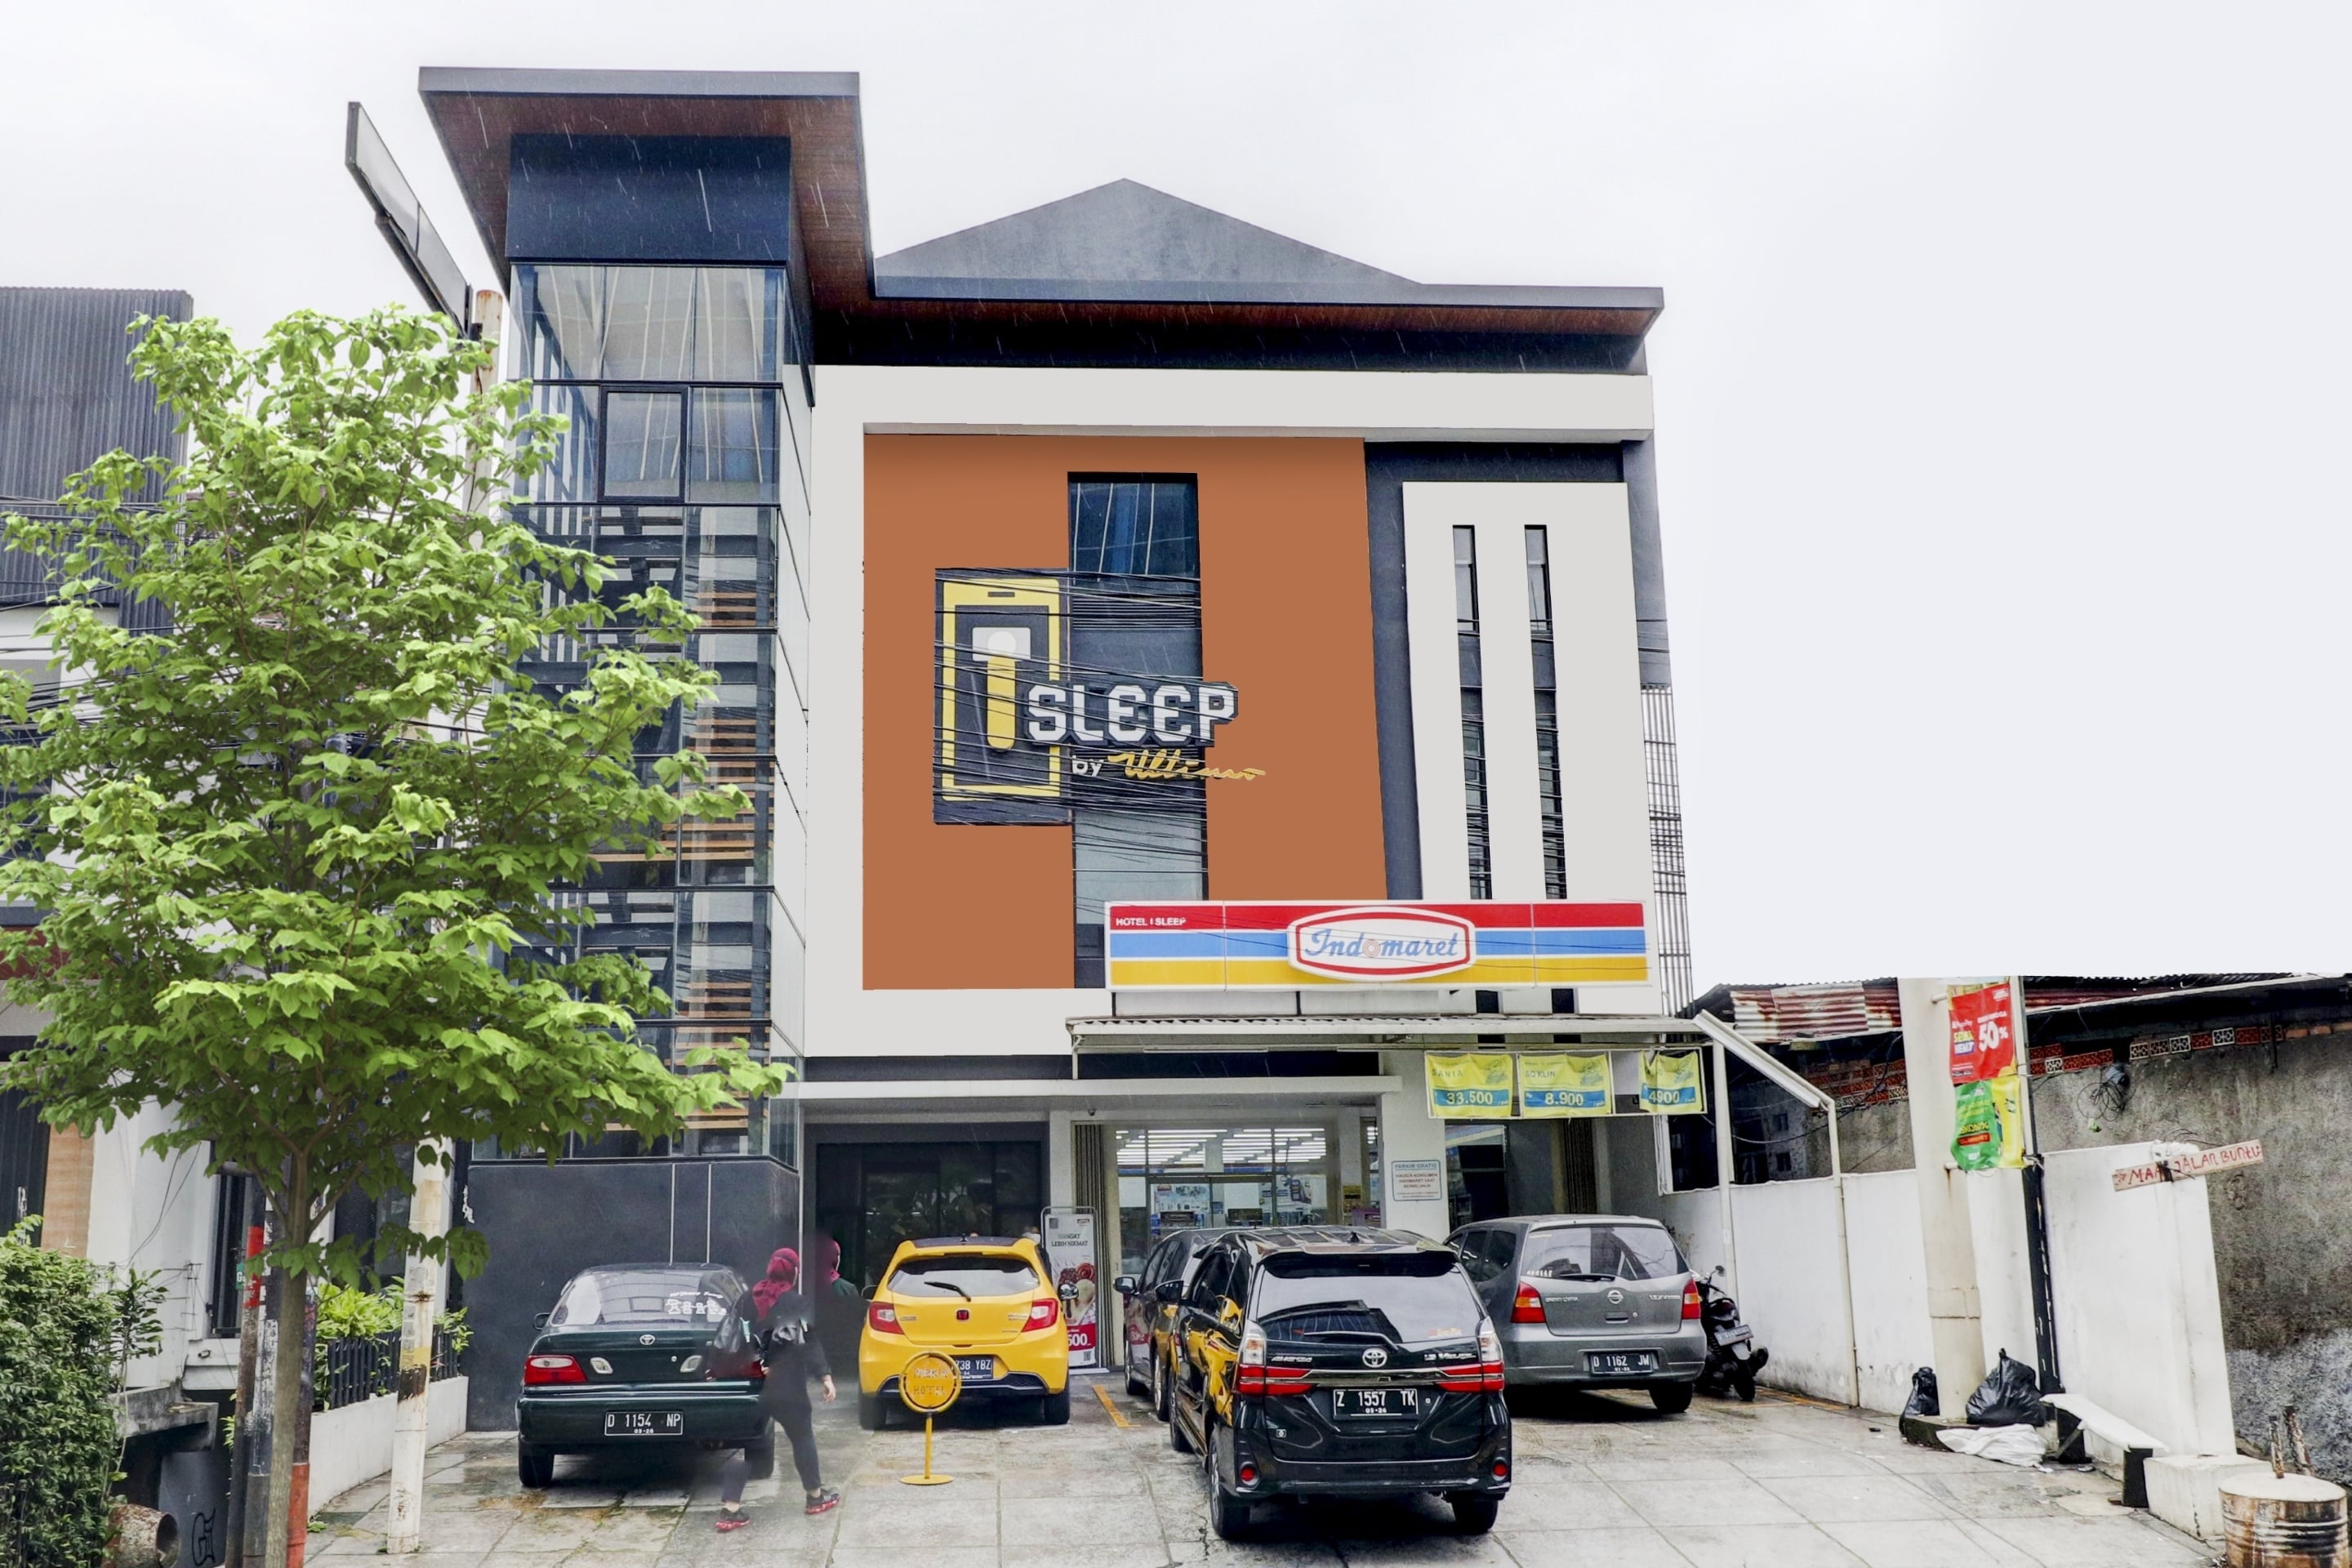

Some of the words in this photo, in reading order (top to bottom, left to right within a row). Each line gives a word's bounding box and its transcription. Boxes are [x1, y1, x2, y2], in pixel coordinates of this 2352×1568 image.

[1027, 684, 1236, 742] SLEEP
[1071, 755, 1104, 777] by
[1116, 917, 1148, 926] HOTEL
[1155, 916, 1187, 926] SLEEP
[1305, 928, 1459, 957] Indomaret
[1446, 1091, 1494, 1105] 33.500
[1544, 1092, 1584, 1106] 8.900
[2174, 1152, 2219, 1173] JALAN
[975, 1359, 991, 1370] YBZ
[1592, 1356, 1600, 1367] D
[1606, 1355, 1628, 1367] 1162
[1637, 1354, 1650, 1366] JW
[1336, 1391, 1345, 1407] Z
[1357, 1391, 1387, 1407] 1557
[1400, 1390, 1415, 1406] TK
[607, 1414, 615, 1428] D
[625, 1413, 652, 1428] 1154
[666, 1413, 681, 1428] NP
